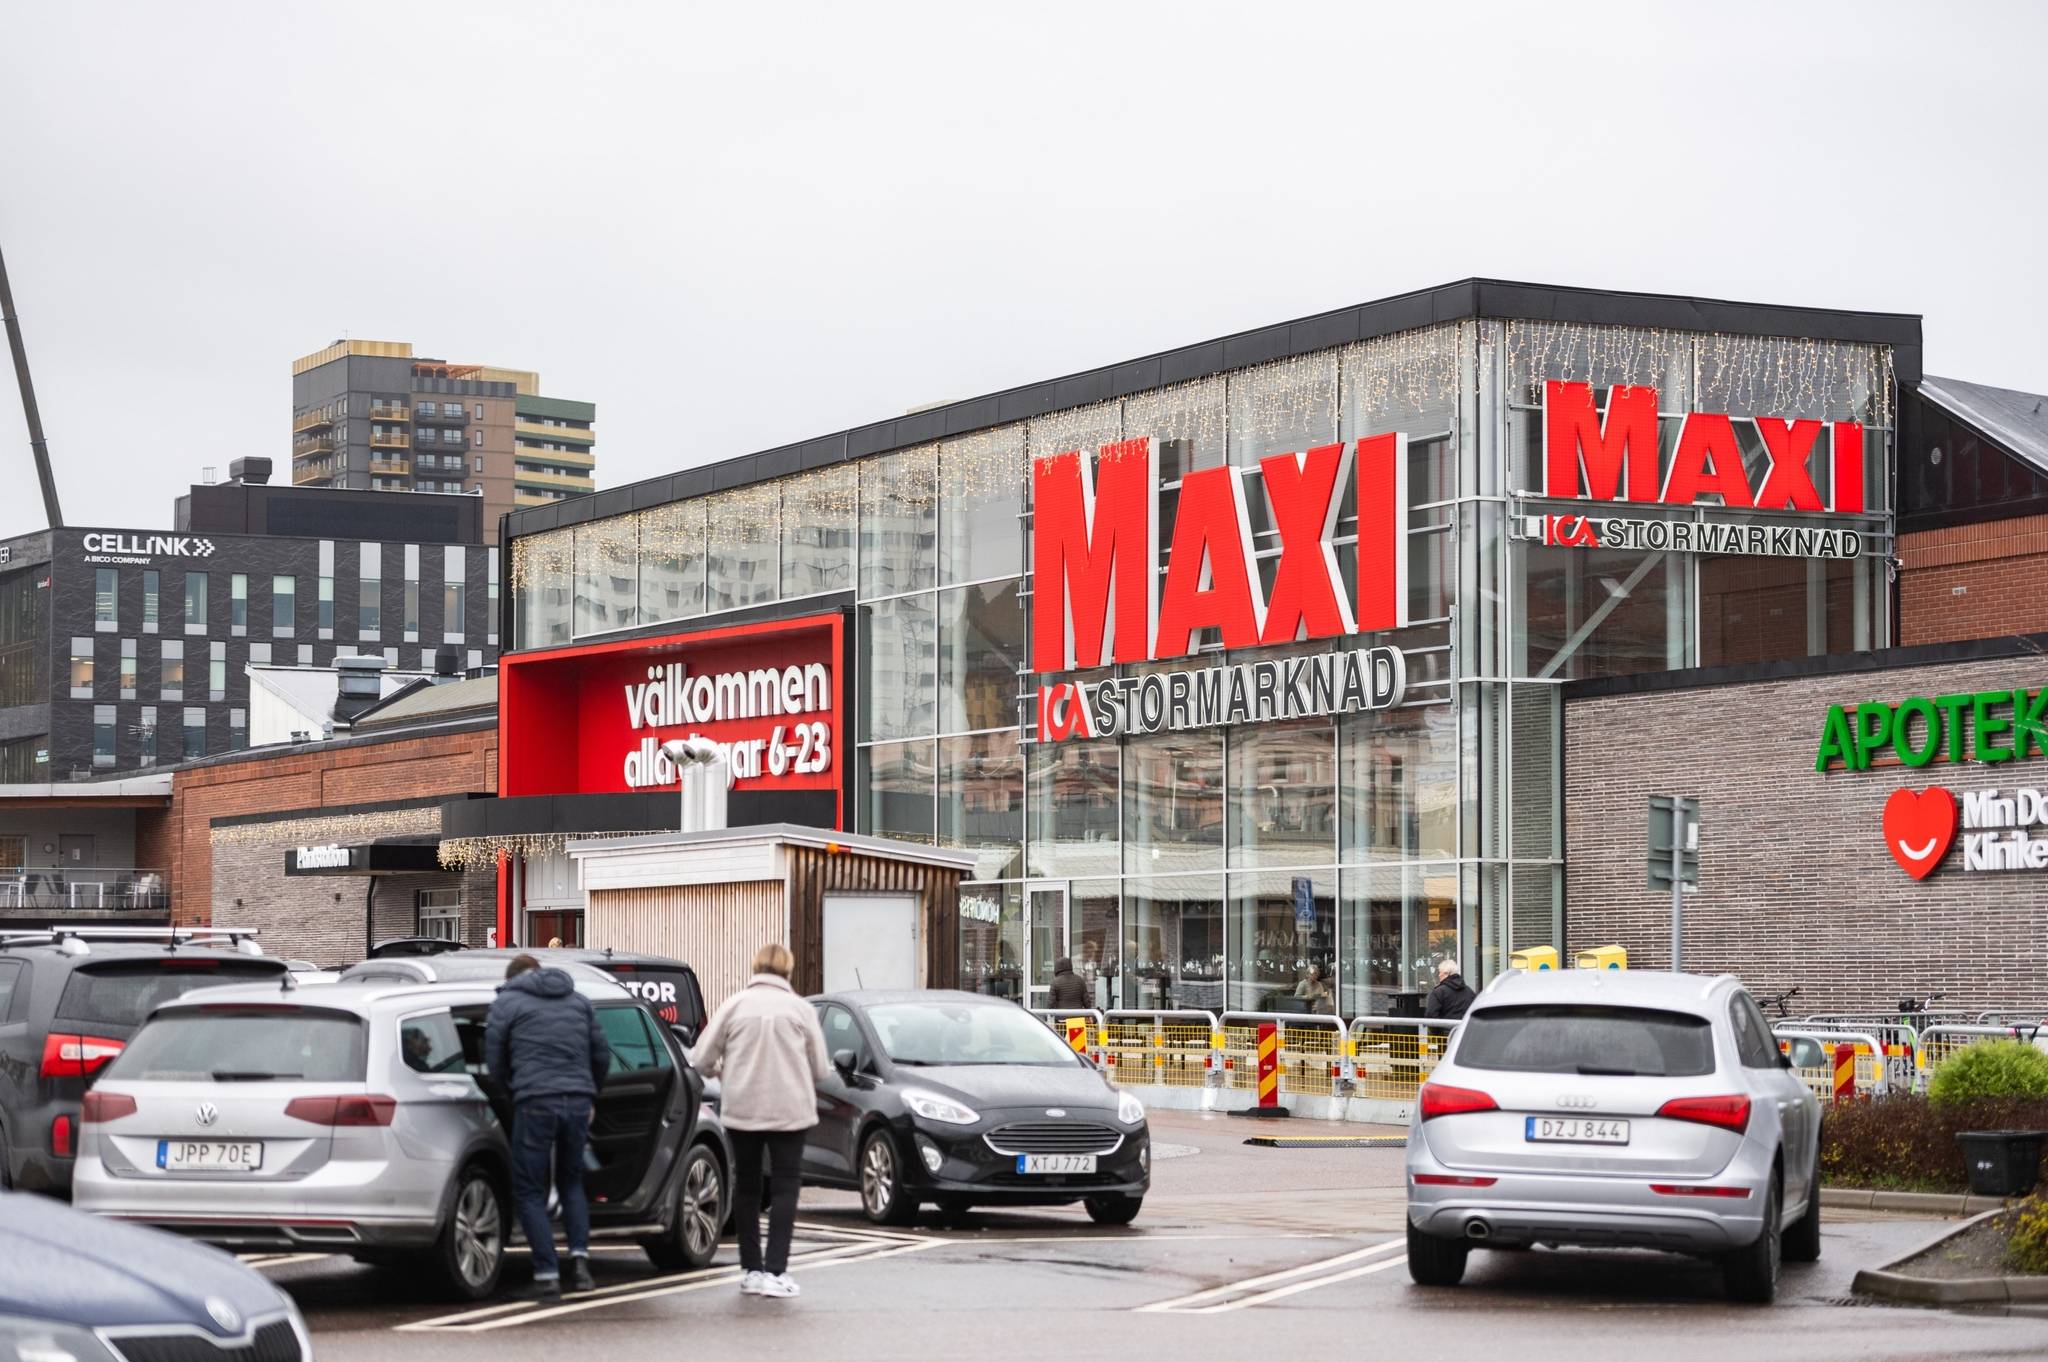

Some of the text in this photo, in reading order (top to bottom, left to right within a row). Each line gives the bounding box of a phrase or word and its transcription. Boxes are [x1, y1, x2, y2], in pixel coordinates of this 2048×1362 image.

[1542, 380, 1863, 513] MAXI
[1033, 432, 1408, 673] MAXI
[1543, 513, 1862, 559] ICA STORMARKNAD
[111, 556, 151, 565] COMPANY
[624, 662, 831, 729] välkommen
[1038, 645, 1406, 743] ICA STORMARKNAD
[1815, 687, 2048, 772] APOTEK
[624, 737, 677, 788] alla
[768, 721, 831, 776] 6-23
[1963, 789, 2015, 829] Min
[1964, 829, 2048, 871] Klinike
[620, 981, 677, 1002] TOR
[1542, 1120, 1620, 1139] DZJ 844
[175, 1143, 210, 1163] JPP
[1031, 1156, 1090, 1171] XTJ 772
